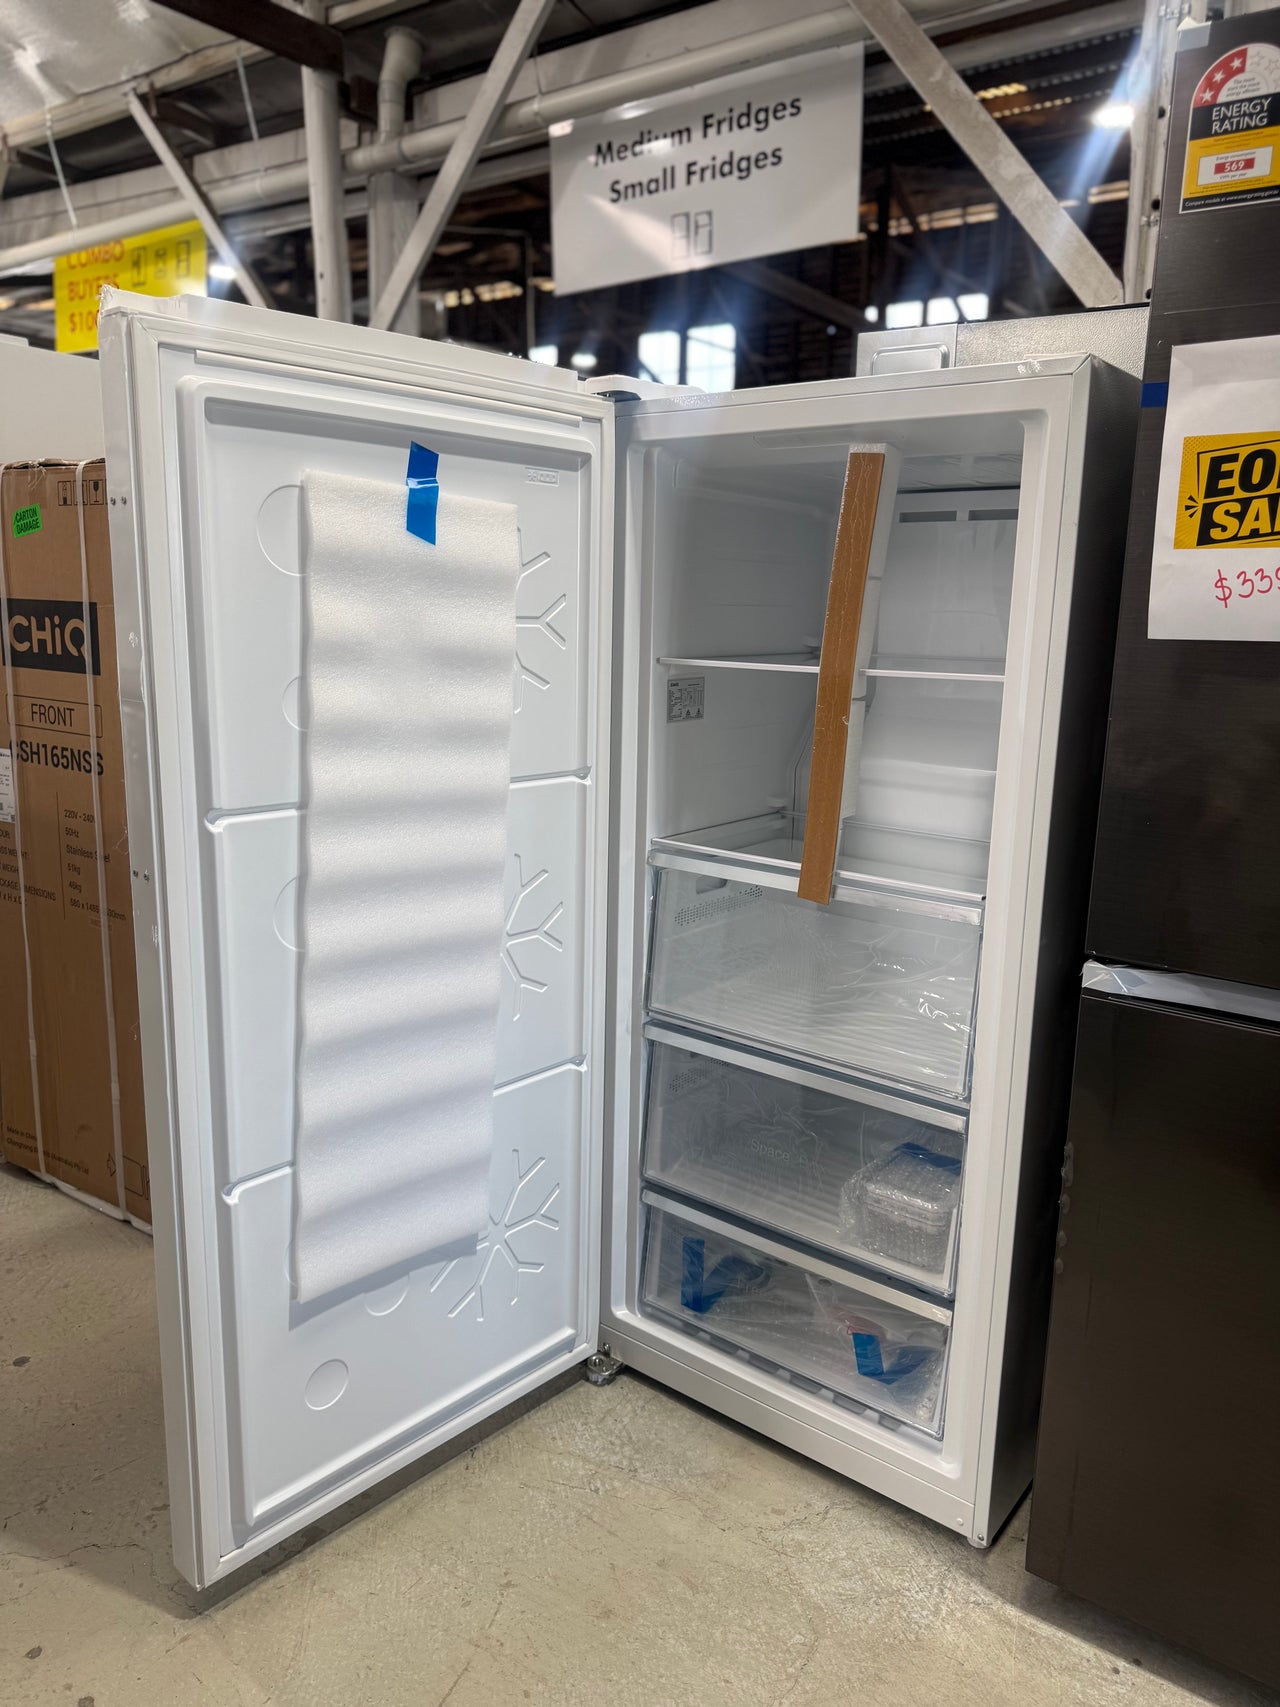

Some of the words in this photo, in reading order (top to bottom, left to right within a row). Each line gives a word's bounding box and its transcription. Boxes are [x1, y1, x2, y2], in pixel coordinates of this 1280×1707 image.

[702, 97, 802, 139] Fridges
[1212, 97, 1272, 120] ENERGY
[1211, 112, 1268, 135] RATING
[609, 165, 675, 203] Small
[686, 146, 783, 187] Fridges
[1224, 160, 1245, 172] 569
[66, 239, 125, 270] COMBO
[1203, 448, 1280, 499] EO
[15, 507, 38, 523] CARTON
[16, 519, 40, 535] DAMAGE
[1209, 496, 1280, 541] SA
[8, 614, 88, 661] CHiQ
[31, 703, 75, 728] FRONT
[83, 813, 96, 824] 240
[751, 1138, 790, 1161] Space
